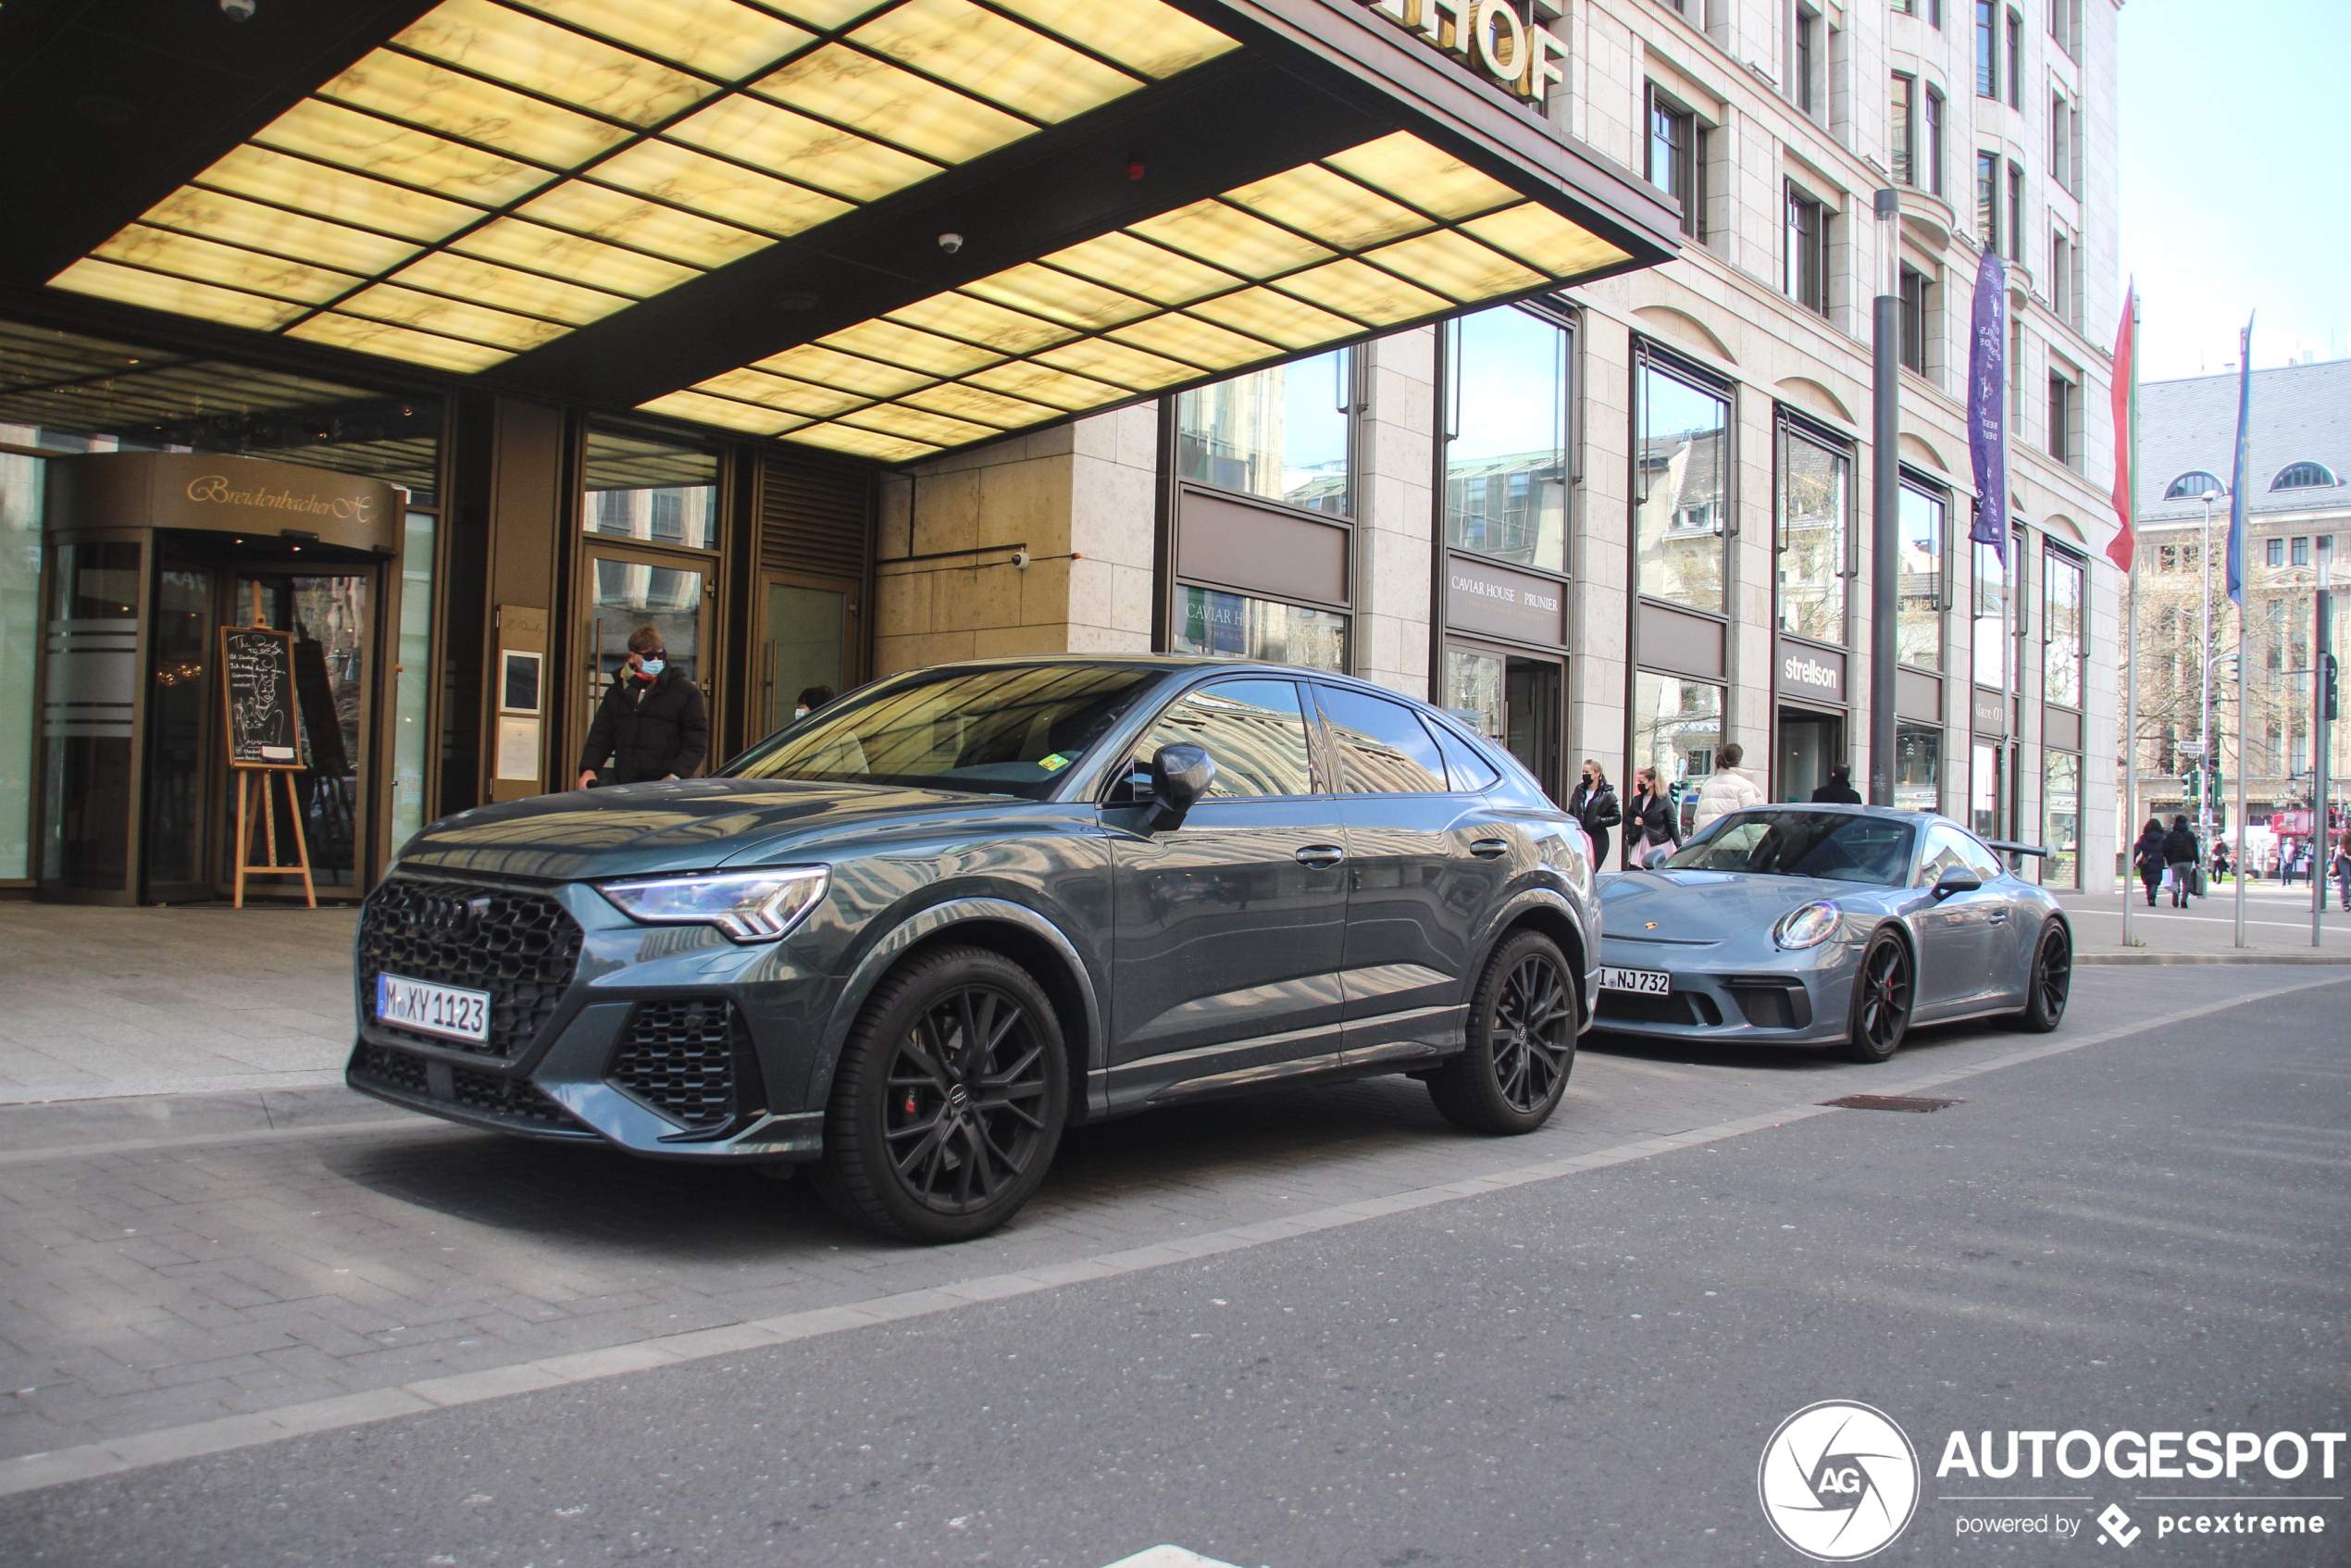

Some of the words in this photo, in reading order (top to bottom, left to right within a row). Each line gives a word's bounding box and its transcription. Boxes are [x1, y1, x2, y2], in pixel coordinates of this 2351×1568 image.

[187, 475, 332, 515] Breidenbacher
[1451, 576, 1485, 595] CAVIAR
[1486, 583, 1515, 602] HOUSE
[1524, 592, 1558, 612] PRUNIER
[1186, 604, 1232, 624] CAVIAR
[1785, 655, 1836, 689] strellson
[1974, 703, 1992, 719] Marc
[1618, 971, 1636, 989] NJ
[1640, 973, 1668, 992] 732
[386, 981, 397, 1014] M
[407, 985, 431, 1021] XY
[433, 990, 484, 1032] 1123
